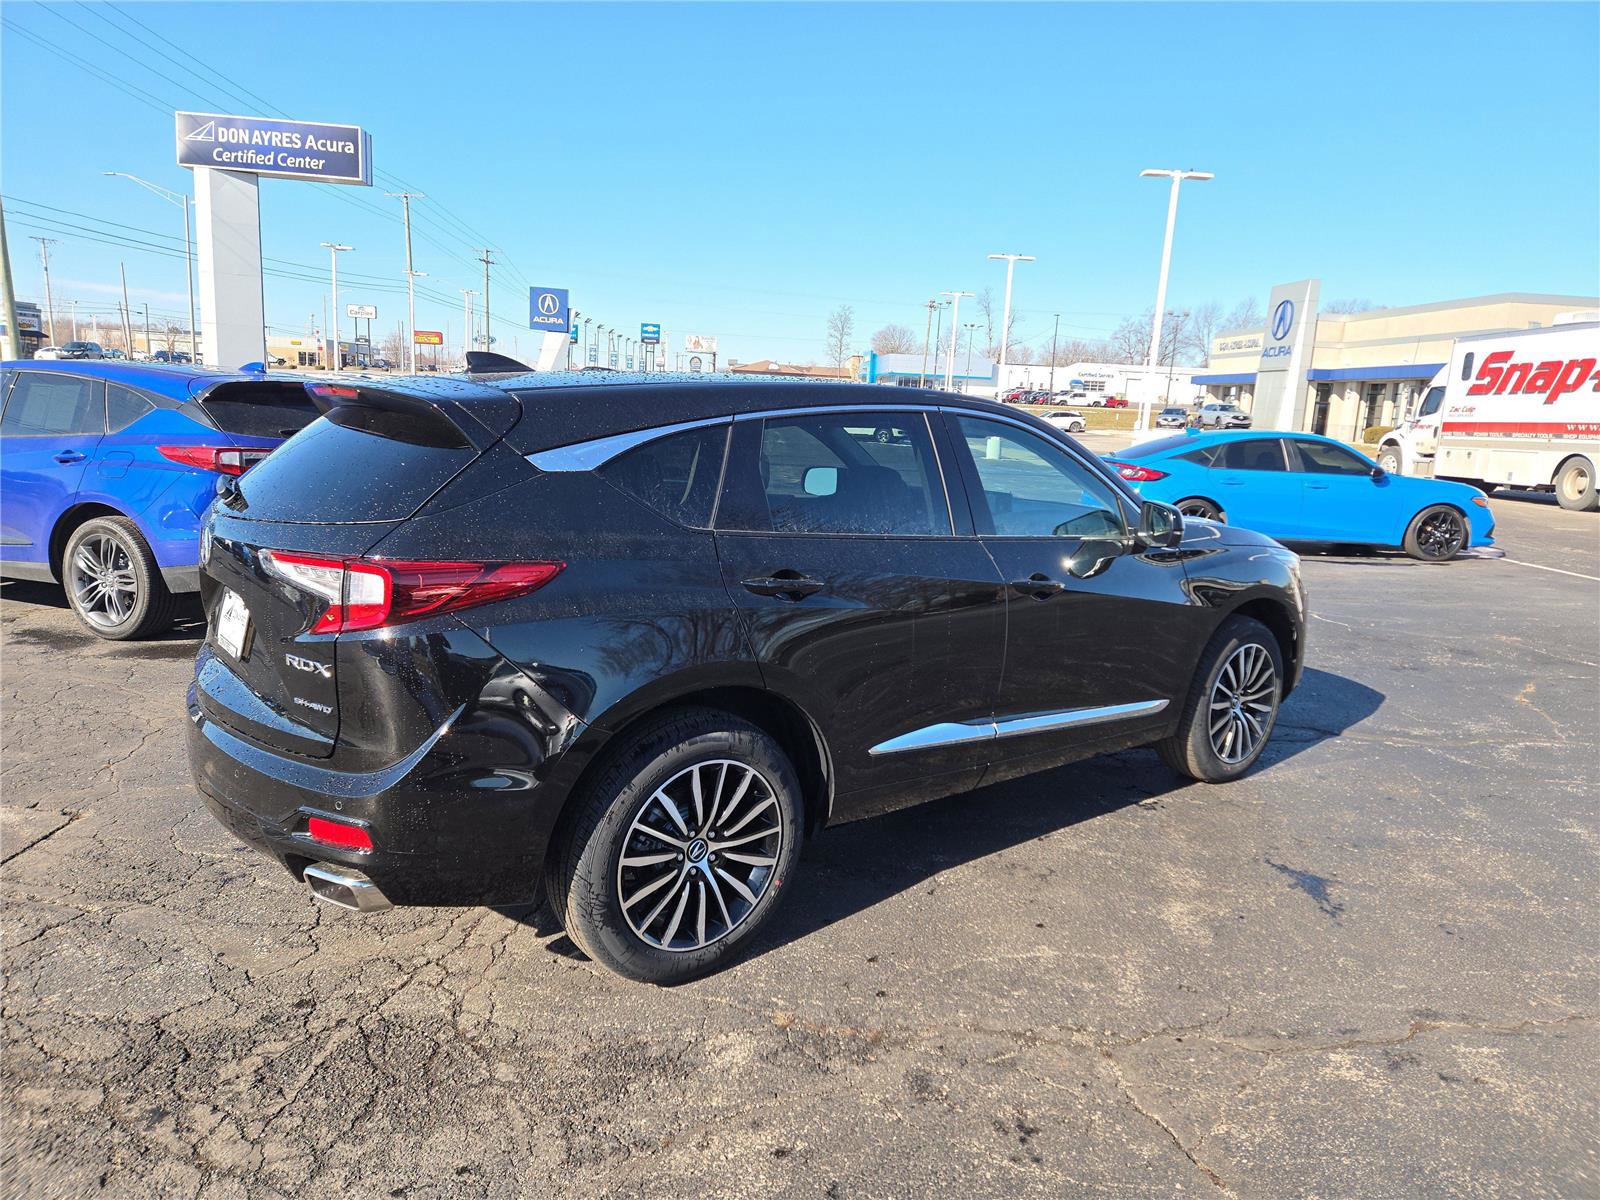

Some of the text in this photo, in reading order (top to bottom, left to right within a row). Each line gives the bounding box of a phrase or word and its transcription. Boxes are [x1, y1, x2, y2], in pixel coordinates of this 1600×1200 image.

[218, 127, 355, 154] DON AYRES Acura
[212, 148, 326, 170] Certified Center
[533, 316, 564, 324] ACURA
[1262, 345, 1292, 359] ACURA
[285, 653, 332, 678] RDX
